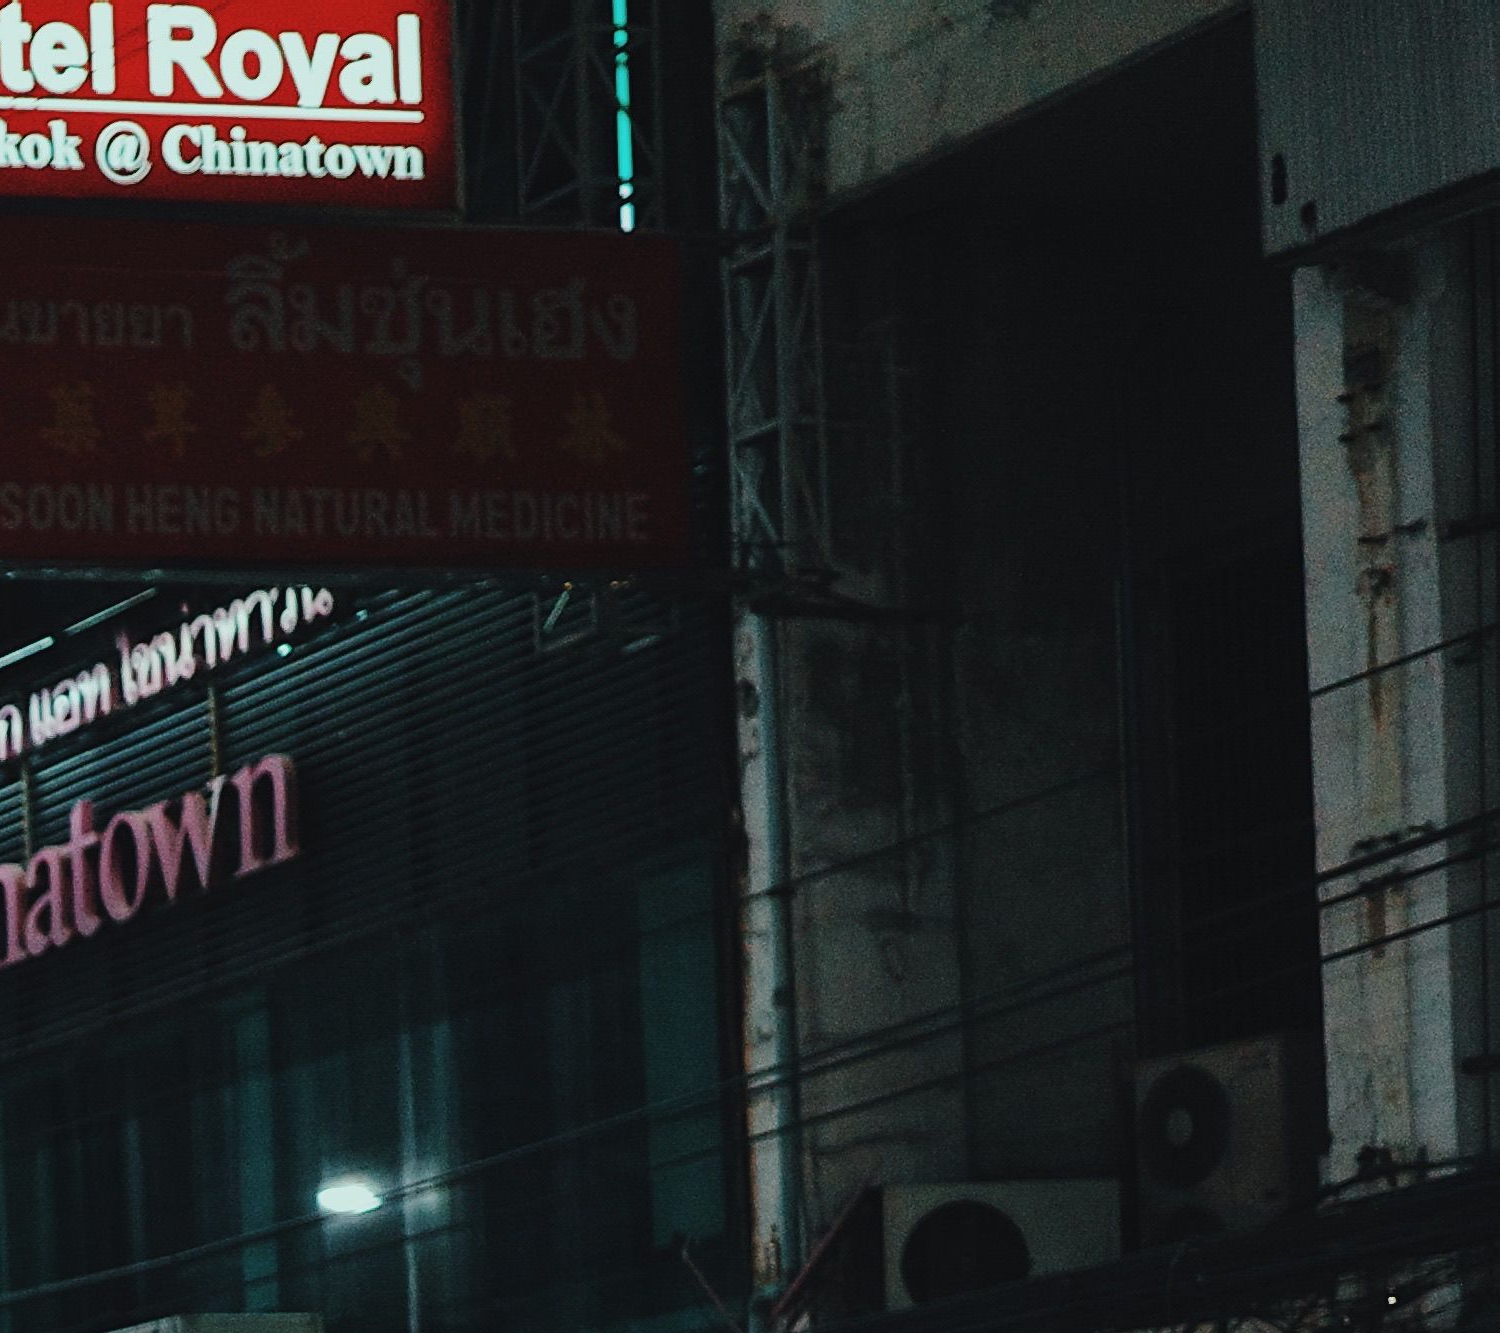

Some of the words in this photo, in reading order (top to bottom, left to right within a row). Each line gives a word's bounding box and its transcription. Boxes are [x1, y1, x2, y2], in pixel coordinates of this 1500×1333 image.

[148, 4, 423, 107] Royal
[95, 120, 152, 184] @
[161, 125, 424, 181] Chinatown
[126, 485, 245, 537] HENG
[252, 488, 438, 539] NATURAL
[449, 490, 652, 542] MEDICINE
